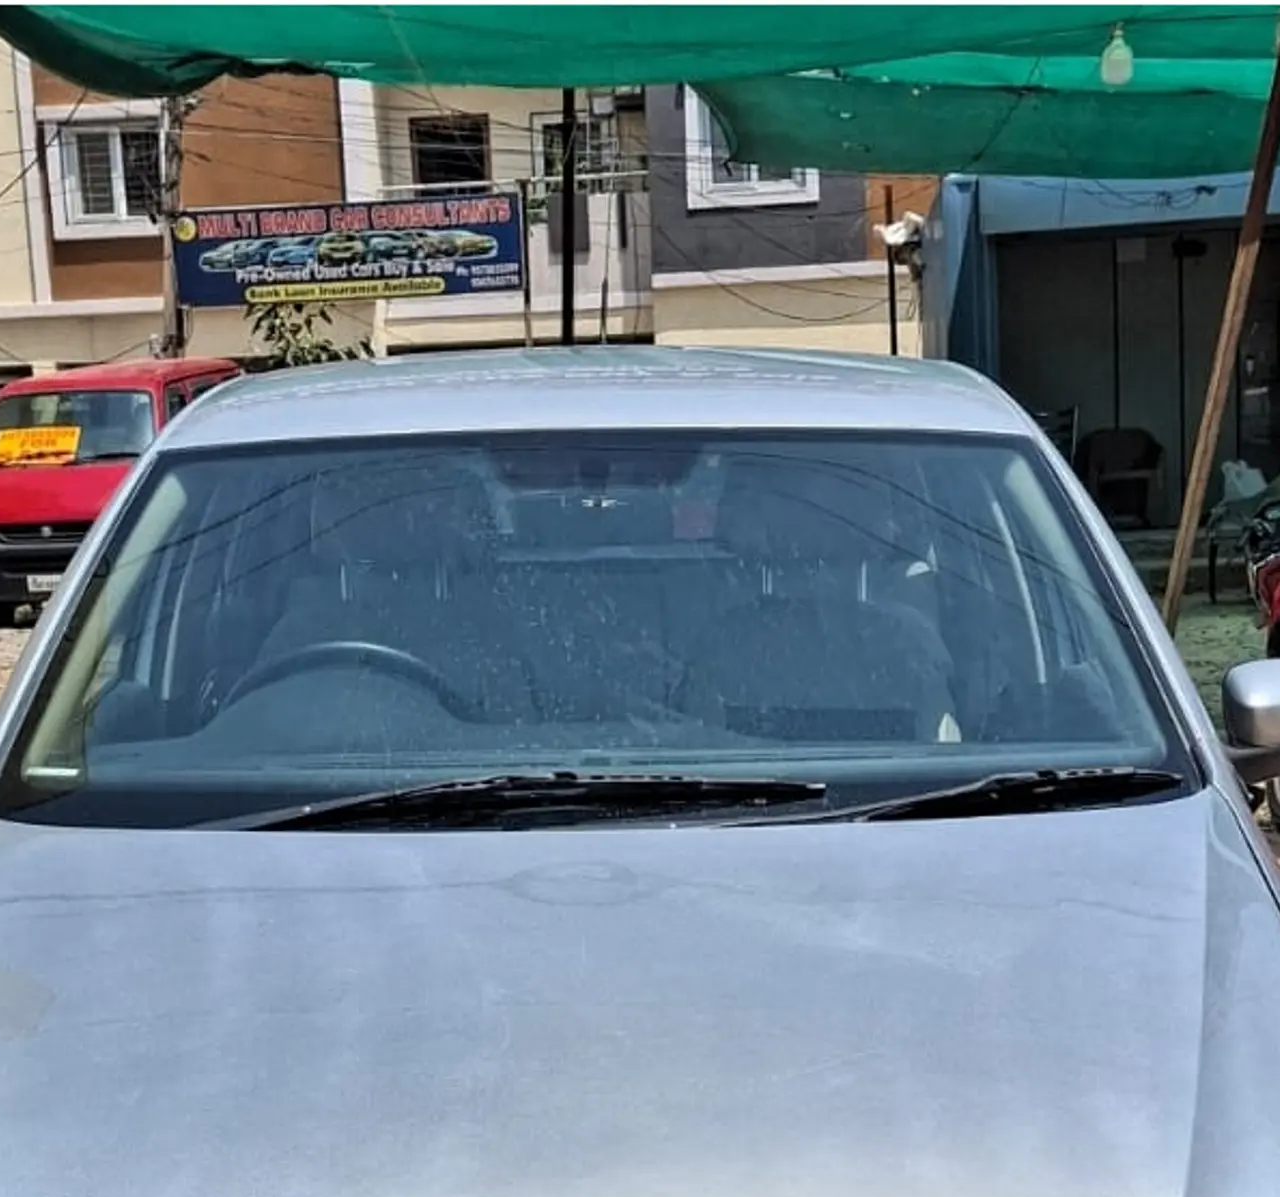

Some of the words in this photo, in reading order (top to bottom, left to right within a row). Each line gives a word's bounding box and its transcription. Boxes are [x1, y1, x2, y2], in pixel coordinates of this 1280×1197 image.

[196, 212, 257, 238] MULTI
[260, 208, 327, 235] BRAND
[330, 206, 369, 231] CAR
[372, 197, 511, 229] CONSULTANTS
[235, 261, 312, 284] Pre-Owned
[351, 260, 380, 278] Cars
